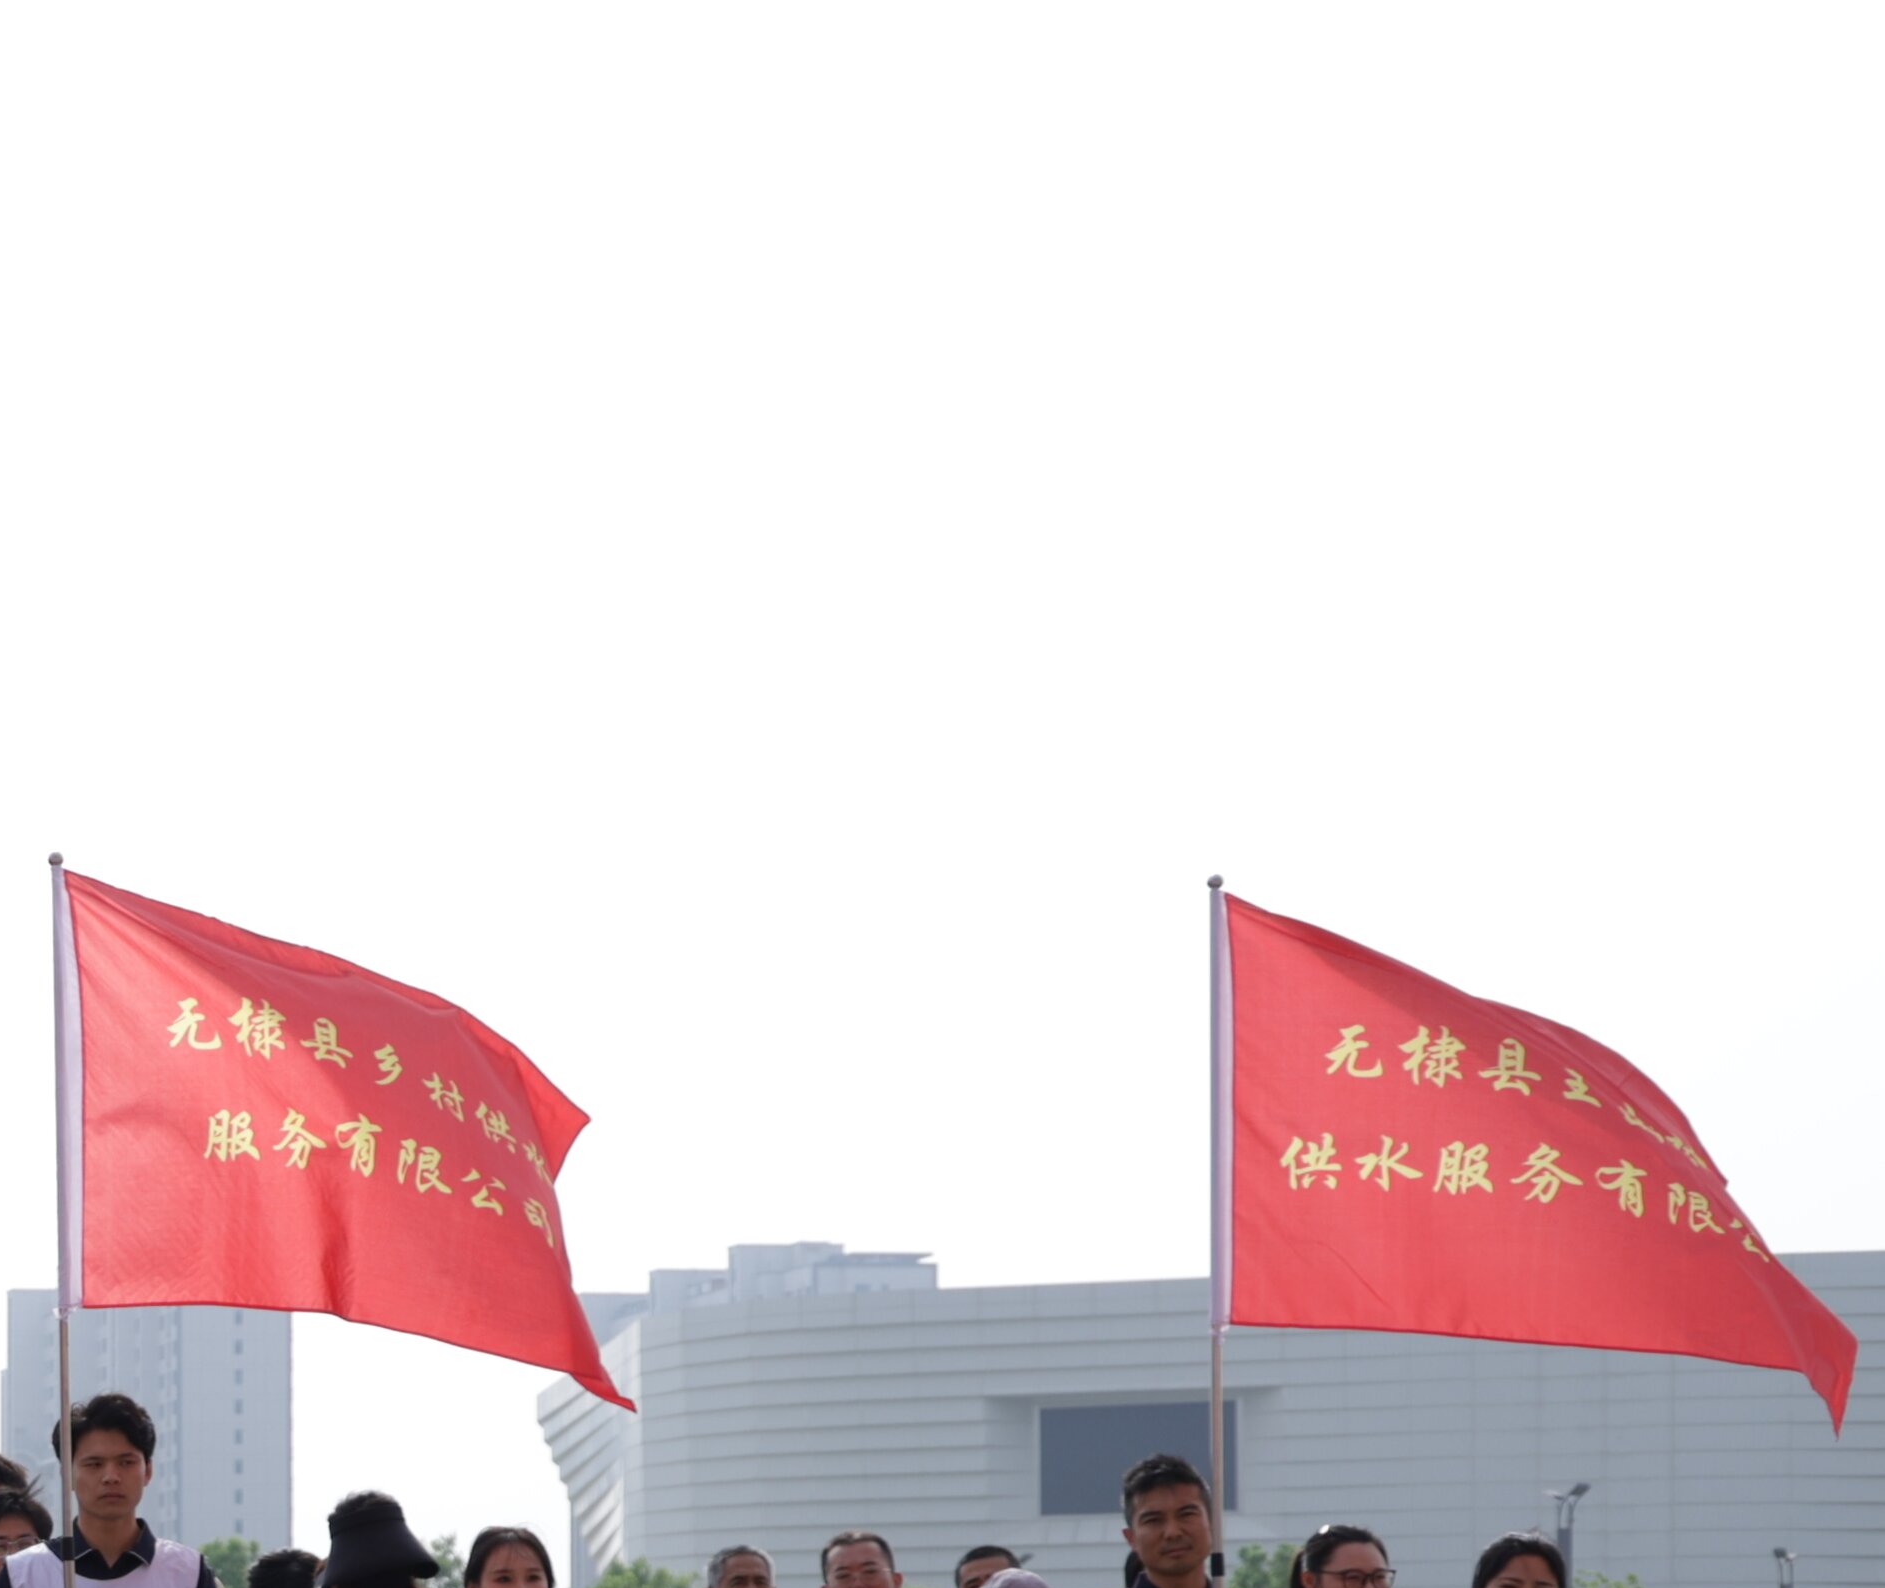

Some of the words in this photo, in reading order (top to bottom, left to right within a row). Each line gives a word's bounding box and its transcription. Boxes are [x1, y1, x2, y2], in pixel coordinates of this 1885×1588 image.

[203, 1107, 556, 1248] 服务有限公司
